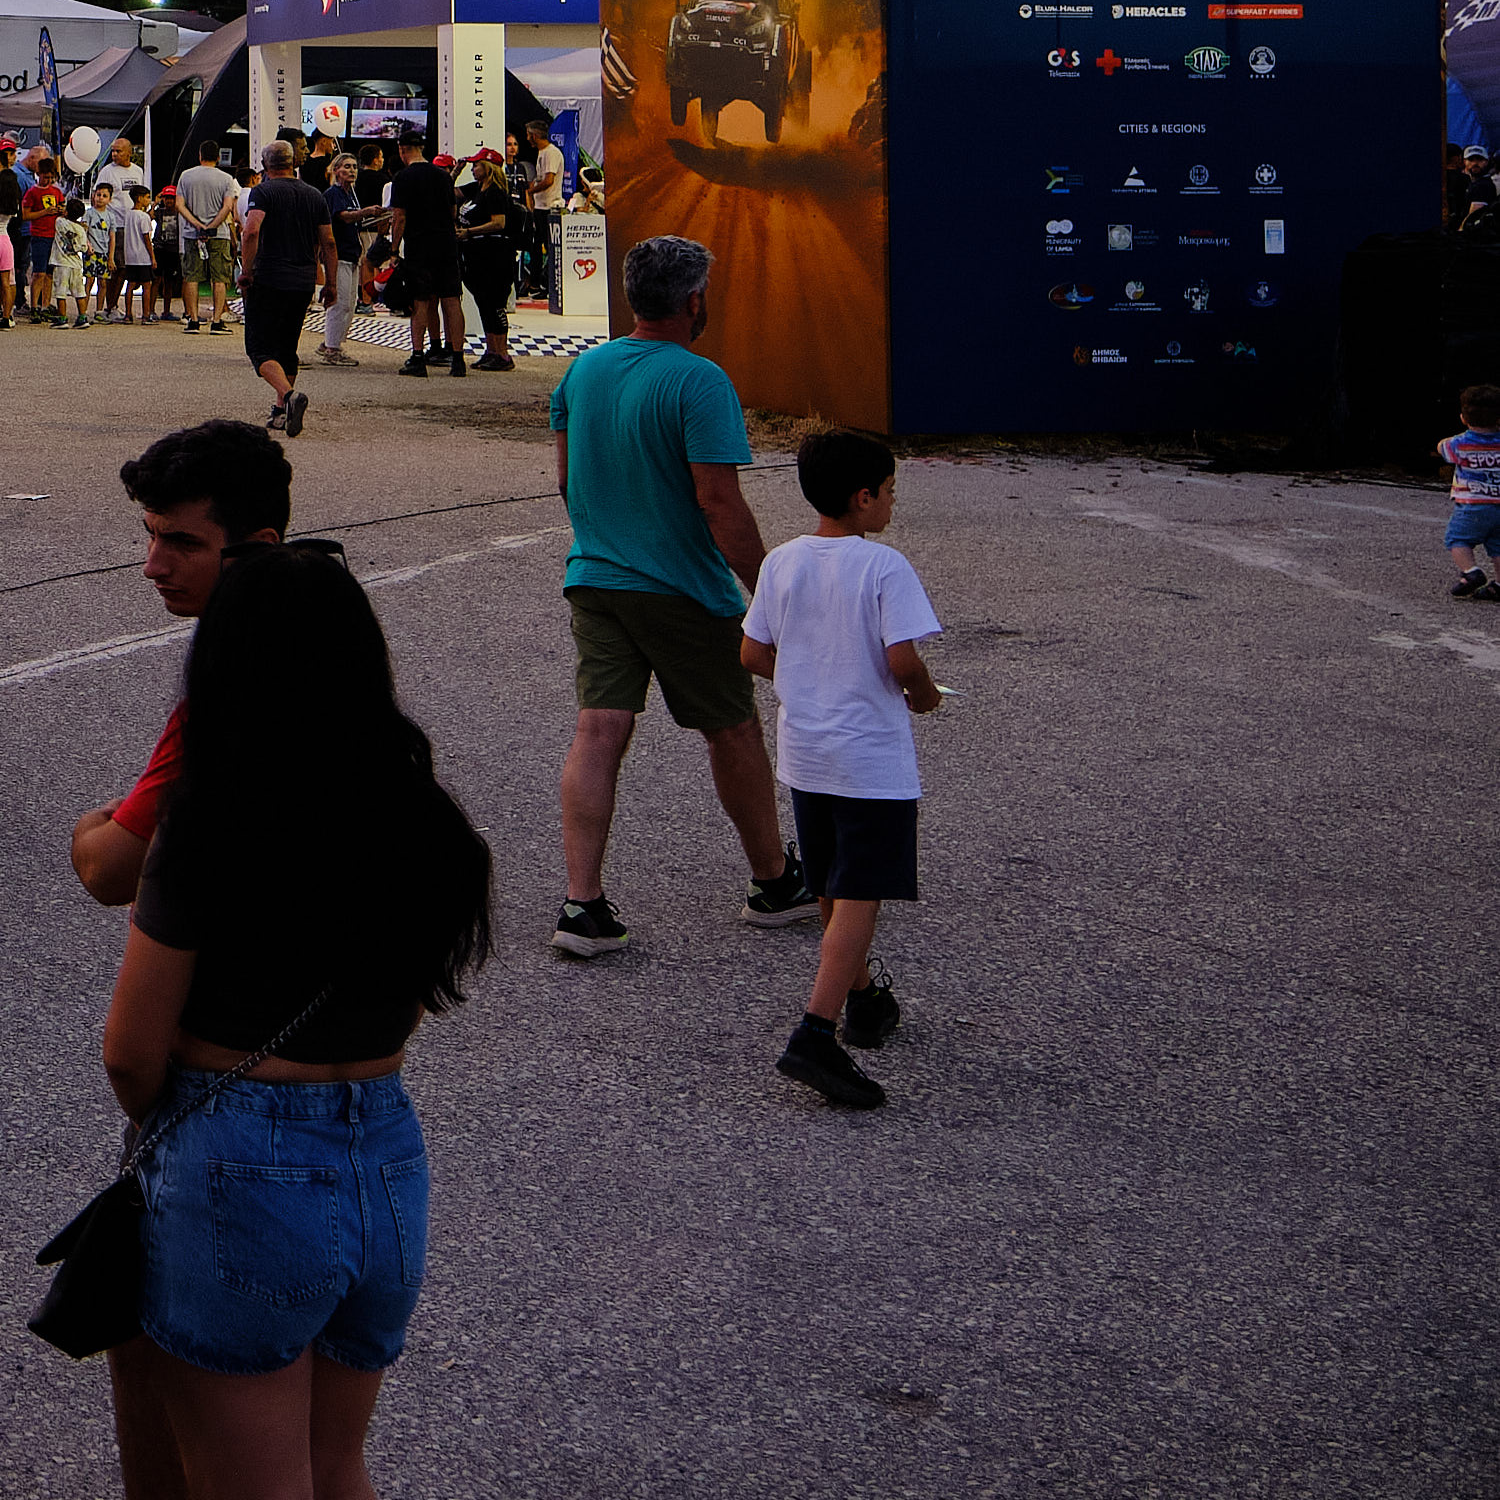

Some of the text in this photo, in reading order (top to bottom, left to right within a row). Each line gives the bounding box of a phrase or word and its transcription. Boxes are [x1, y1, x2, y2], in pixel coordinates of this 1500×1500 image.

[1125, 6, 1187, 18] HERACLES
[474, 53, 484, 129] PARTNER
[1118, 124, 1207, 134] CITIES & REGIONS
[566, 231, 604, 239] PIT STOP
